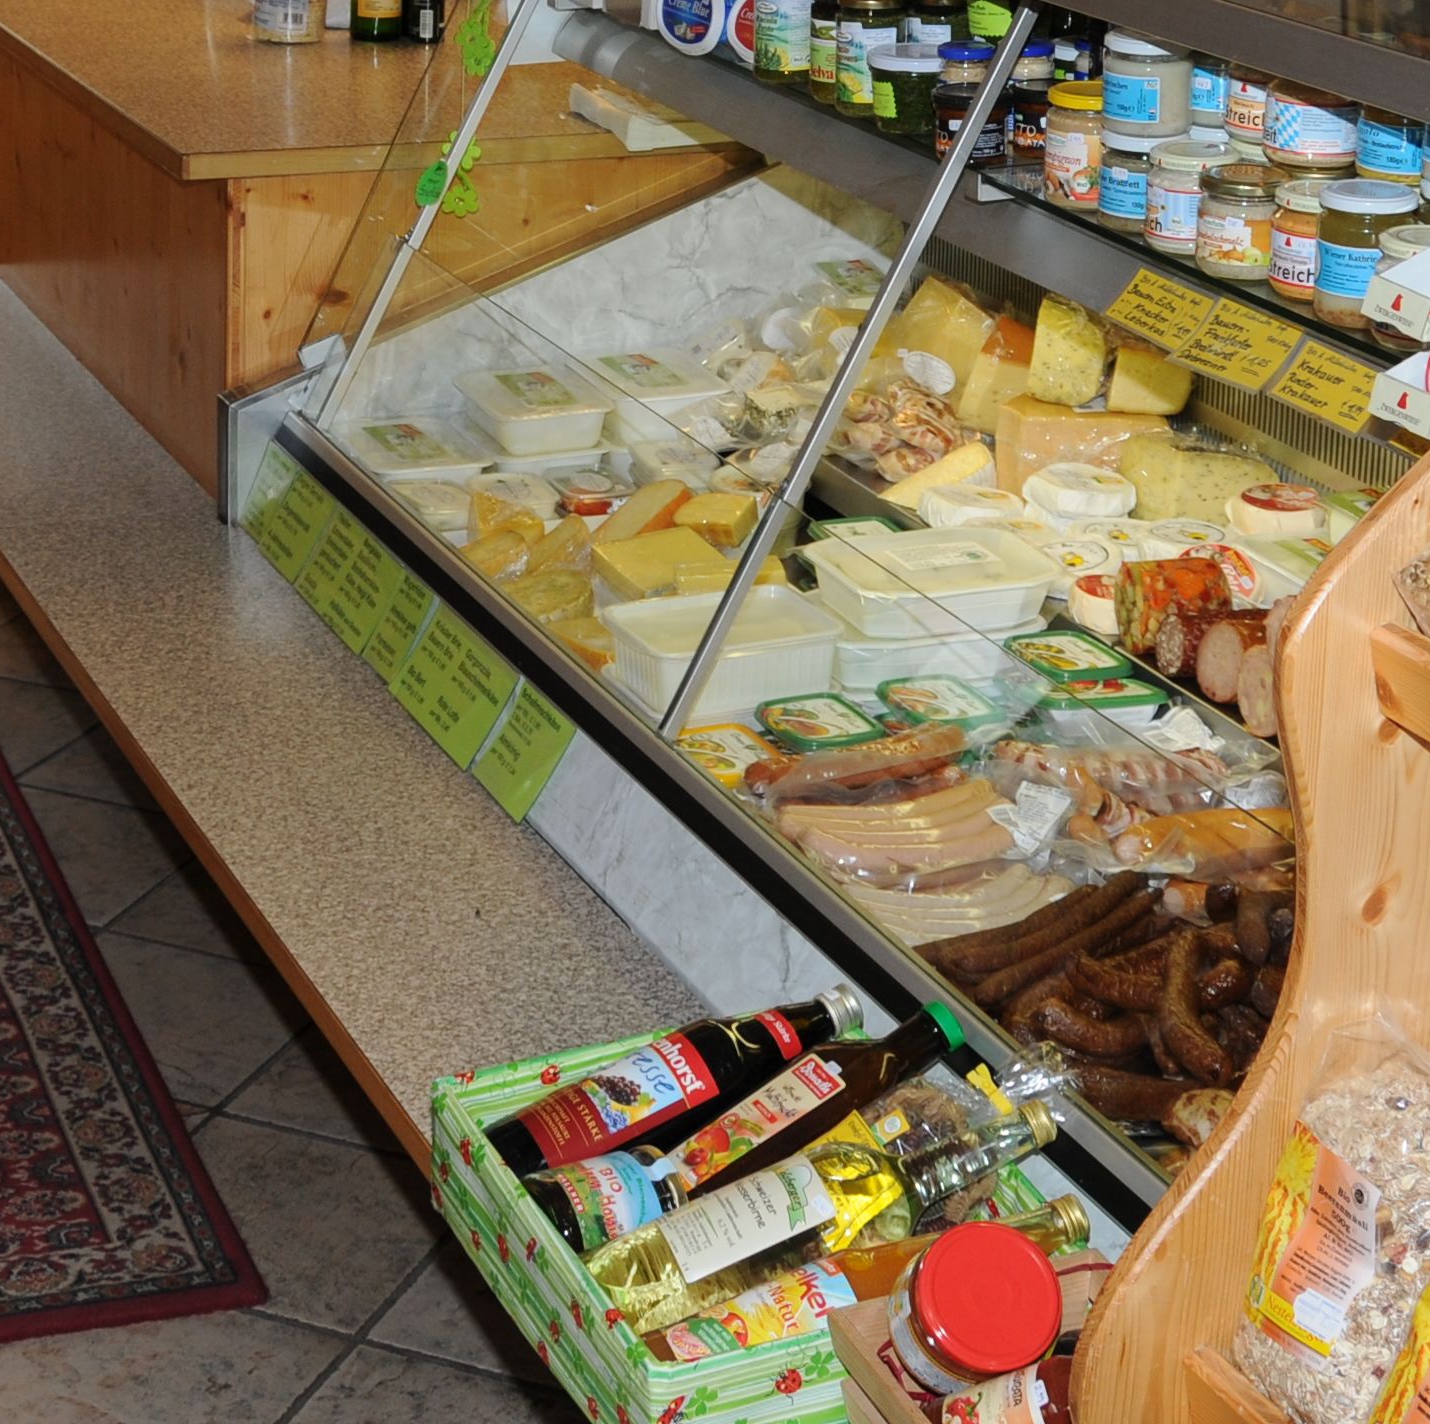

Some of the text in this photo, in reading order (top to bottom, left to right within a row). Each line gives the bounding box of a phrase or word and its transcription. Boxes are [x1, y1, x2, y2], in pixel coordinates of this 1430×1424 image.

[692, 1, 711, 19] Blue
[599, 1166, 623, 1194] BIO
[1337, 1186, 1351, 1204] Bio
[789, 1266, 828, 1320] elkel
